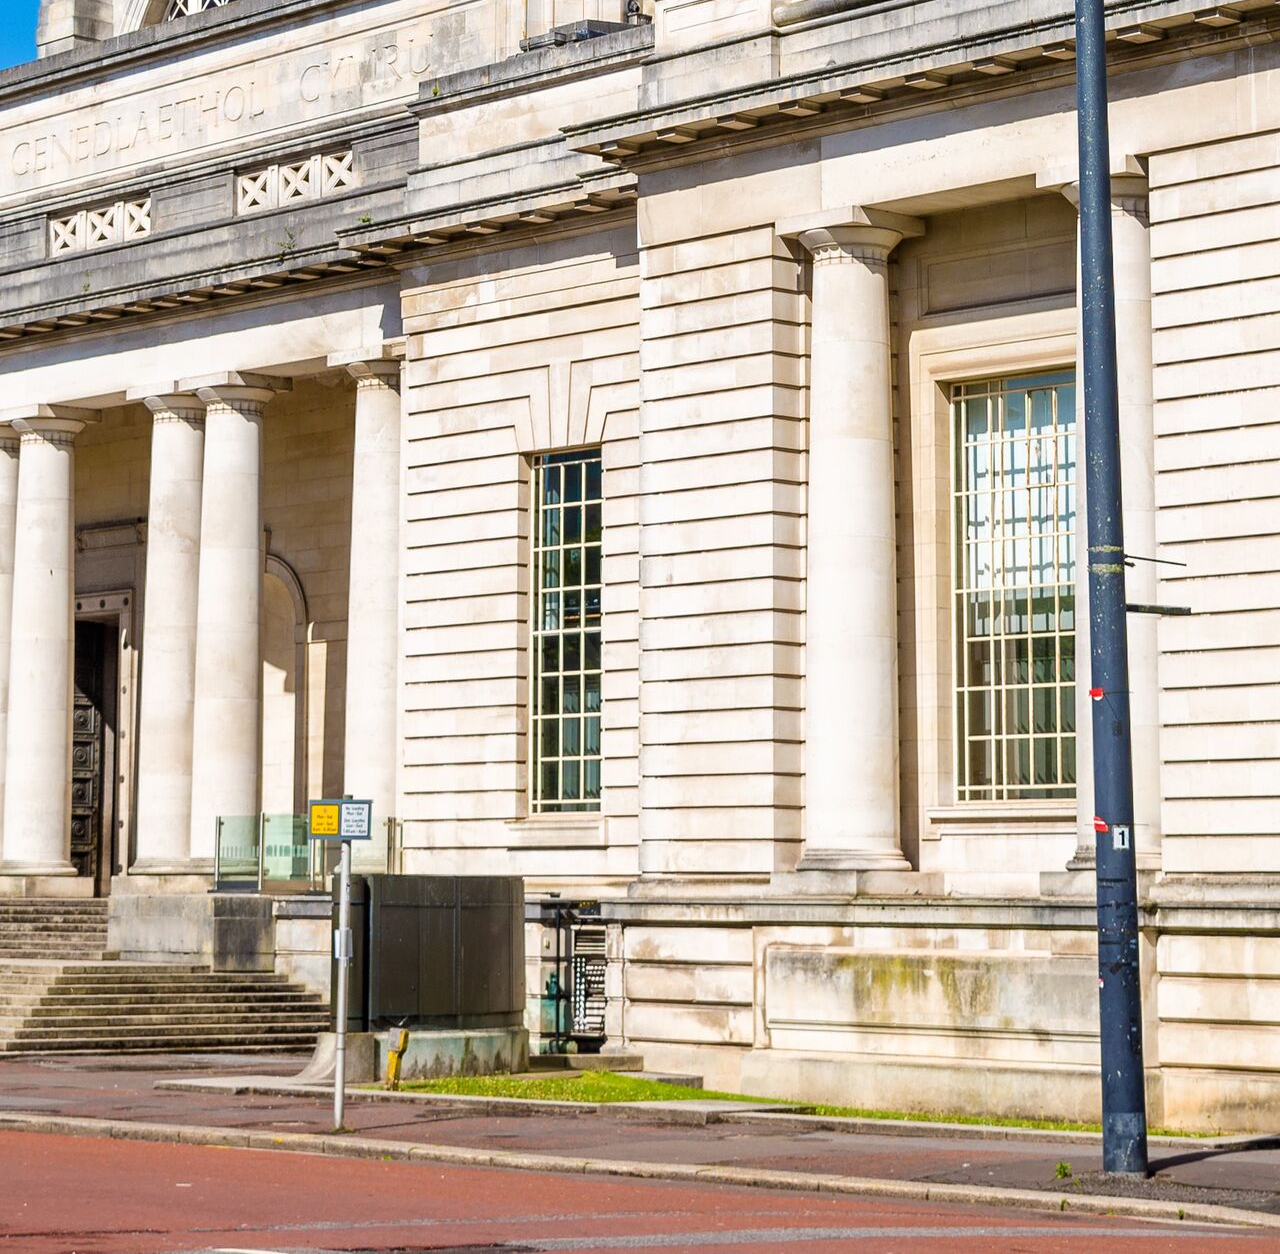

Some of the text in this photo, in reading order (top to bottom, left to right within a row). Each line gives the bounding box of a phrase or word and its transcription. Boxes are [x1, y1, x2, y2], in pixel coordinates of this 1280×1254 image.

[11, 82, 265, 175] GENEDLAETHOL
[300, 33, 433, 102] CYMRU
[1118, 830, 1125, 846] 1
